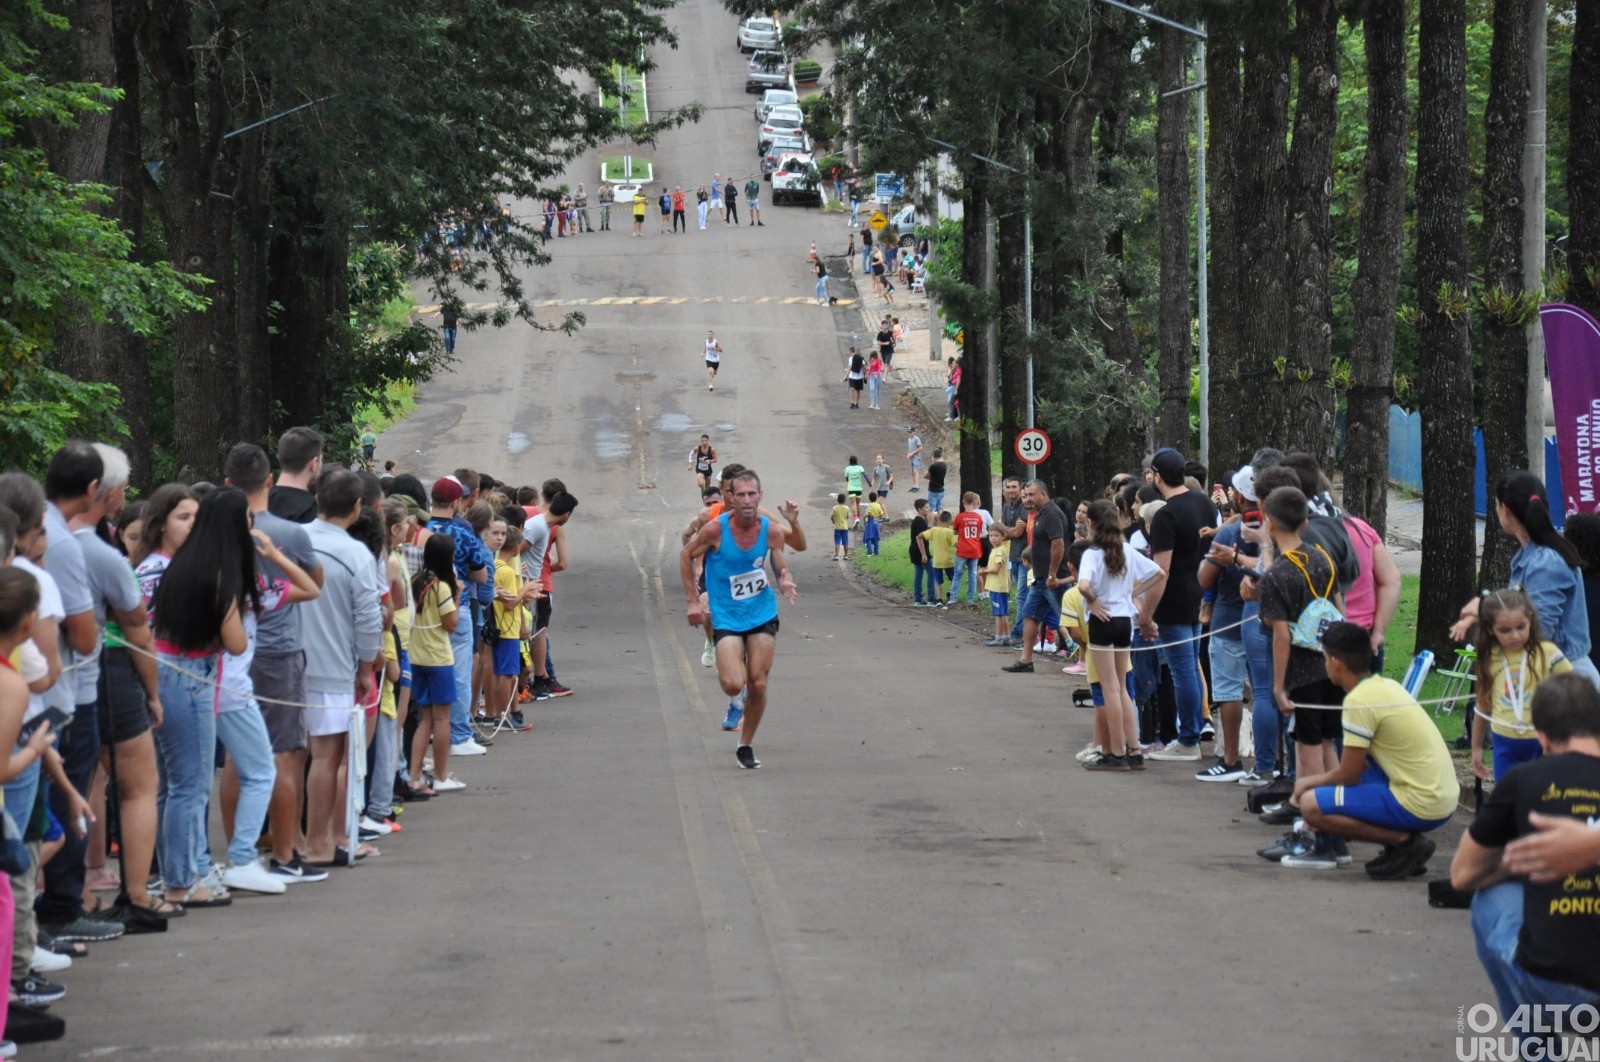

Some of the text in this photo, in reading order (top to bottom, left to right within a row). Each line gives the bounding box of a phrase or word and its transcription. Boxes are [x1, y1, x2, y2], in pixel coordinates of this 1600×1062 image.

[1022, 437, 1043, 451] 30
[1576, 413, 1595, 502] MARATONA
[964, 525, 978, 539] 09
[733, 578, 765, 597] 212
[1549, 896, 1600, 916] PONTO
